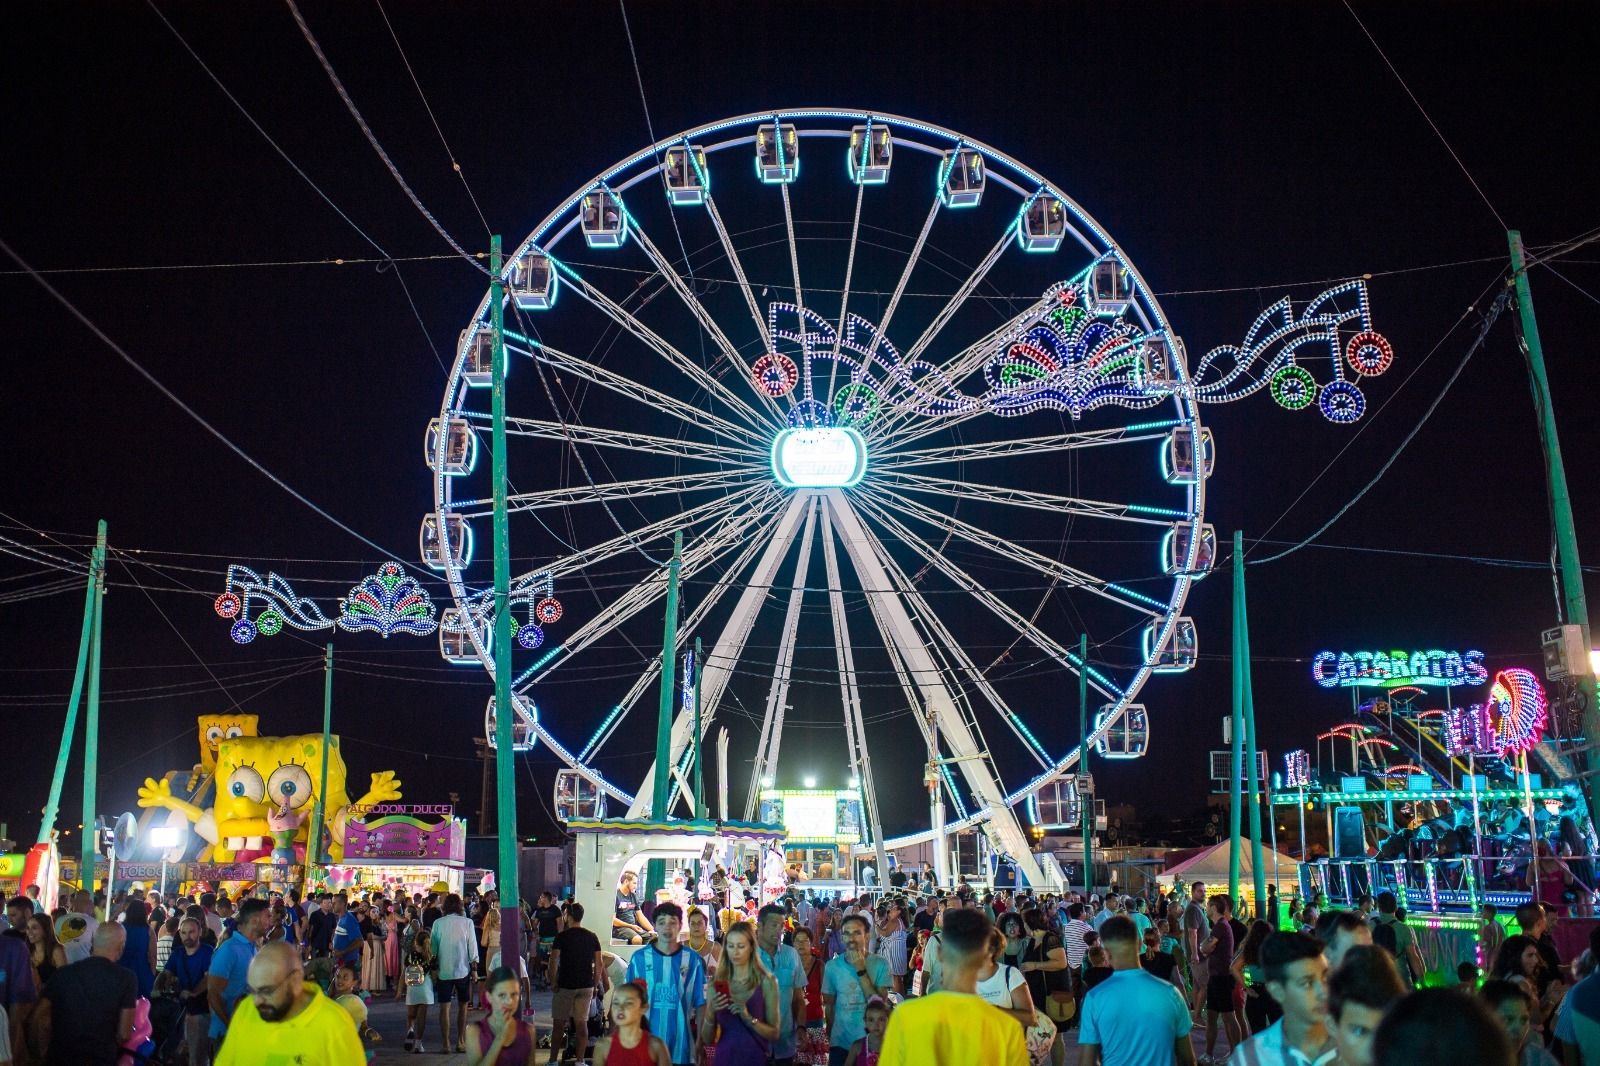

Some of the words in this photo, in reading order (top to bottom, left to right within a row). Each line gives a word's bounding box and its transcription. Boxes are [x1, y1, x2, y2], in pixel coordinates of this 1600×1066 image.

[1312, 650, 1488, 687] CATARATAS
[347, 804, 407, 814] ALGODON
[413, 804, 449, 814] DULCE
